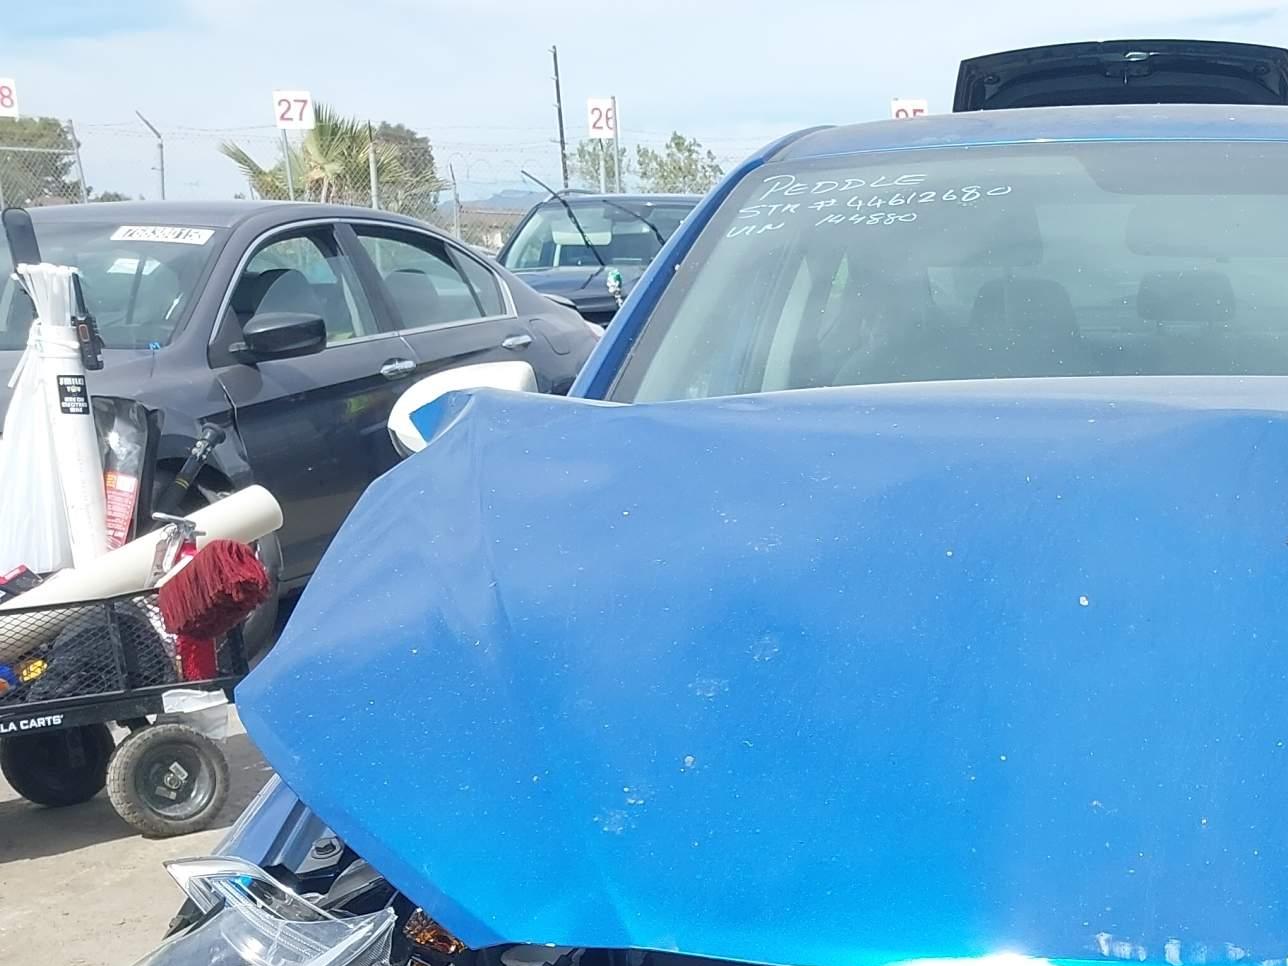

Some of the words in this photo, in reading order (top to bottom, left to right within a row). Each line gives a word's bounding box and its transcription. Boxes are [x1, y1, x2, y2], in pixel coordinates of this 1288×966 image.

[277, 98, 308, 121] 27
[763, 174, 927, 200] PEDDLE
[726, 221, 785, 238] VIN
[815, 212, 918, 227] 144880
